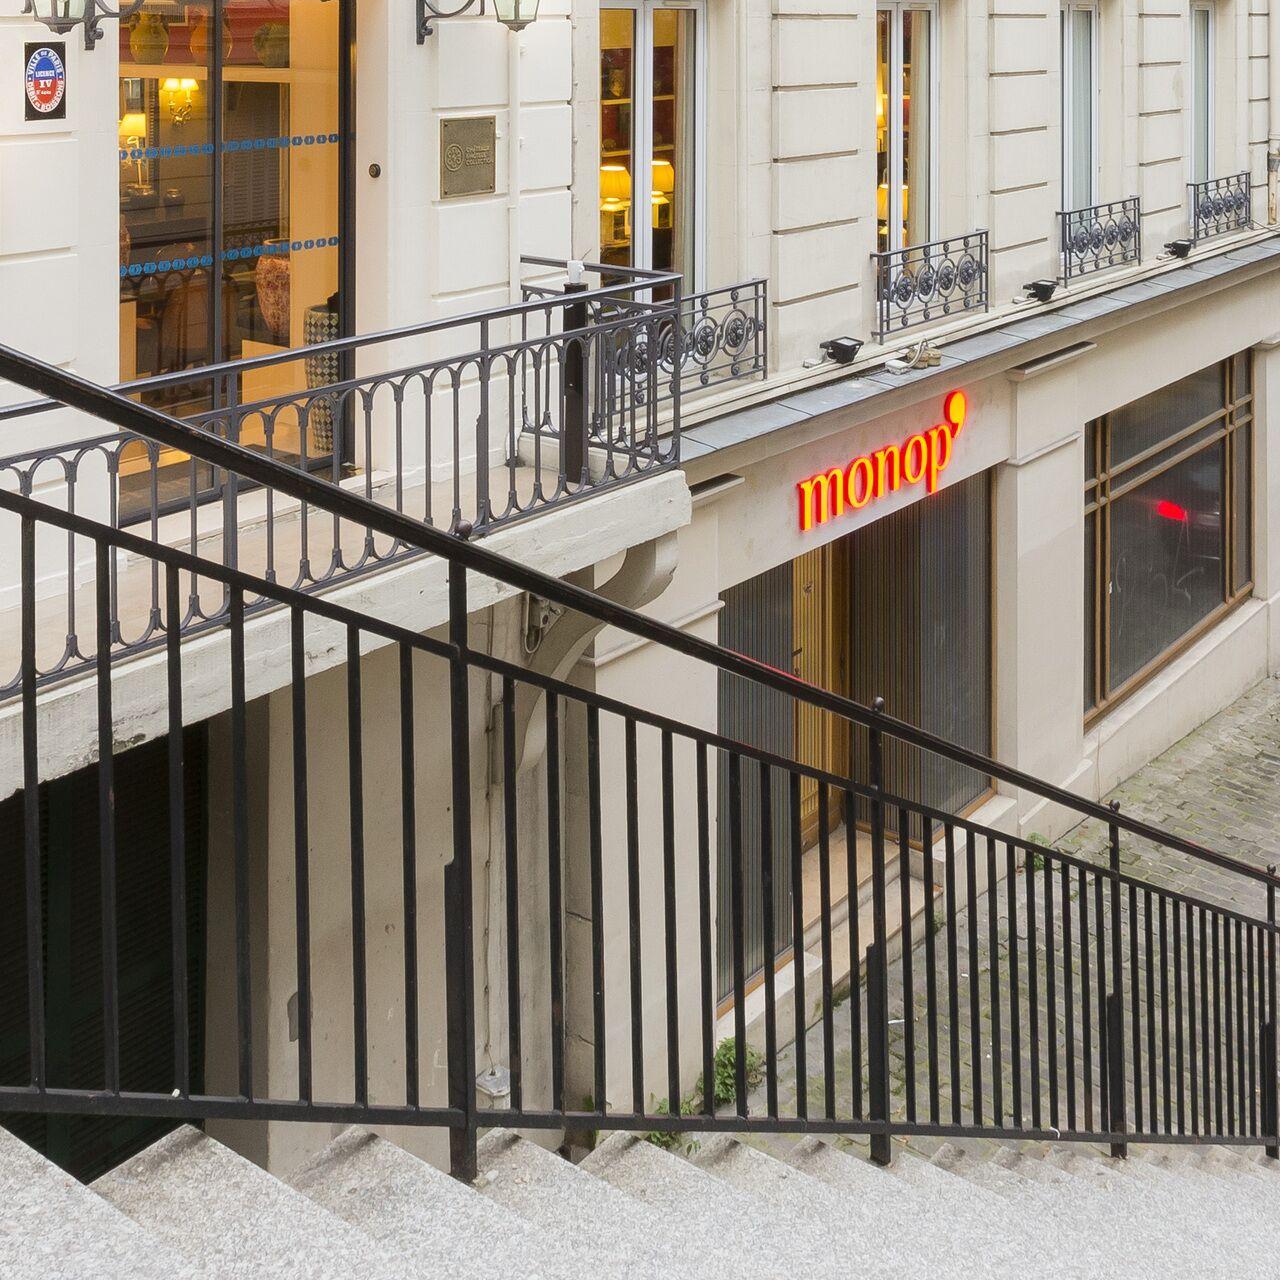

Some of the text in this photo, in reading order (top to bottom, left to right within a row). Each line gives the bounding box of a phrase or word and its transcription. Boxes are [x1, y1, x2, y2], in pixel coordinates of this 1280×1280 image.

[27, 53, 41, 75] VILLE
[48, 51, 63, 73] PARIS
[39, 80, 52, 89] IV
